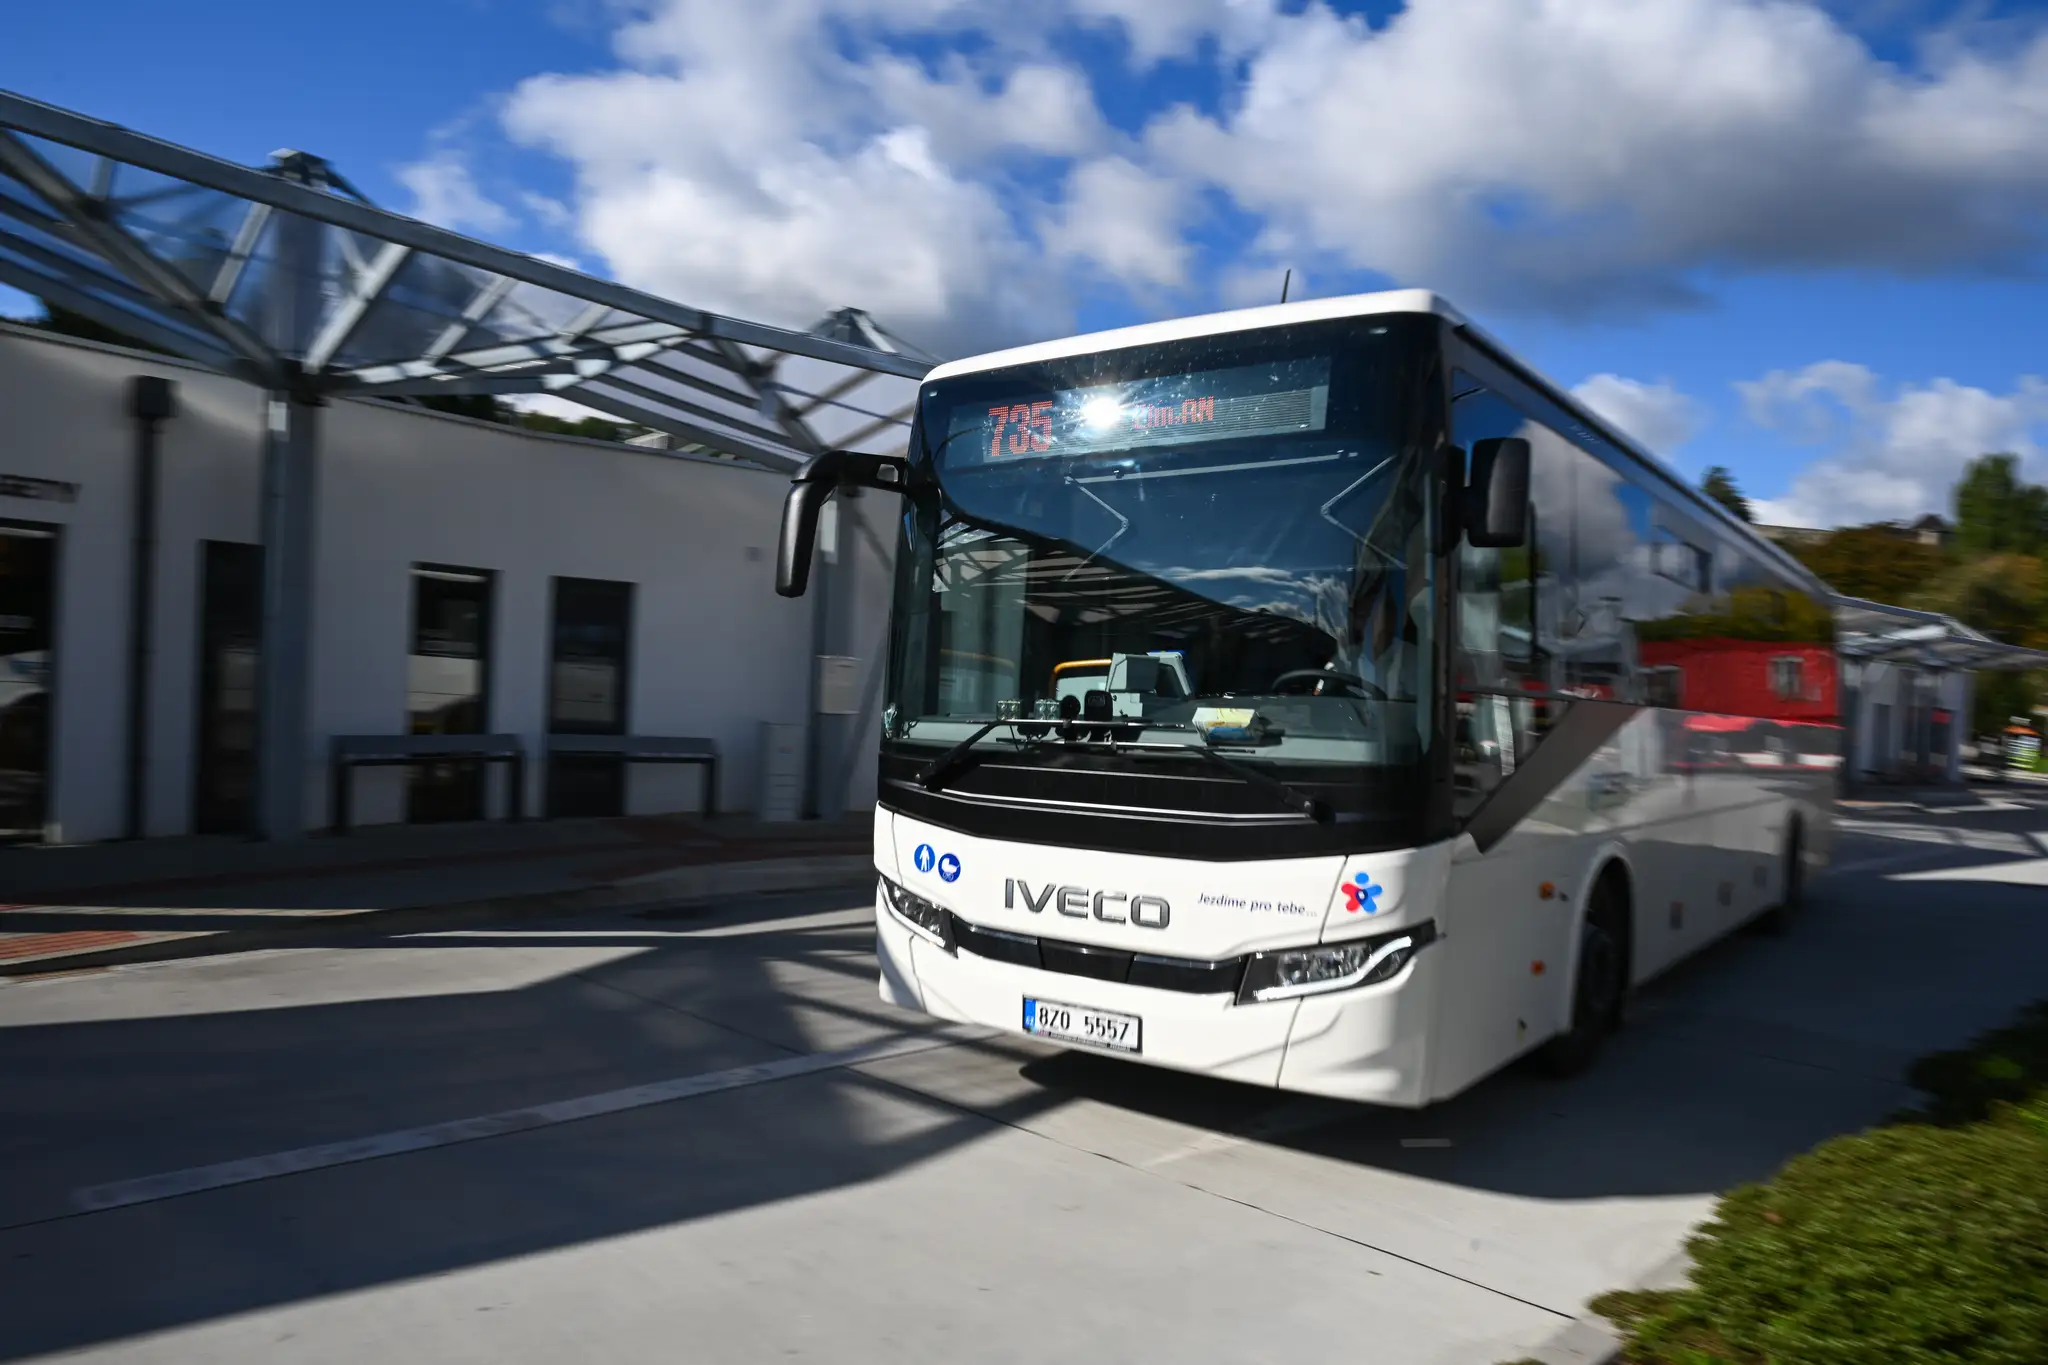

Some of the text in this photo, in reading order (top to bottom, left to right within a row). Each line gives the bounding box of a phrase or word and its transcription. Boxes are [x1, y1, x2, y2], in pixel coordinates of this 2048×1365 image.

[988, 400, 1053, 457] 735
[1004, 878, 1171, 930] IVECO
[1249, 900, 1272, 913] pro
[1084, 1014, 1130, 1042] 5557
